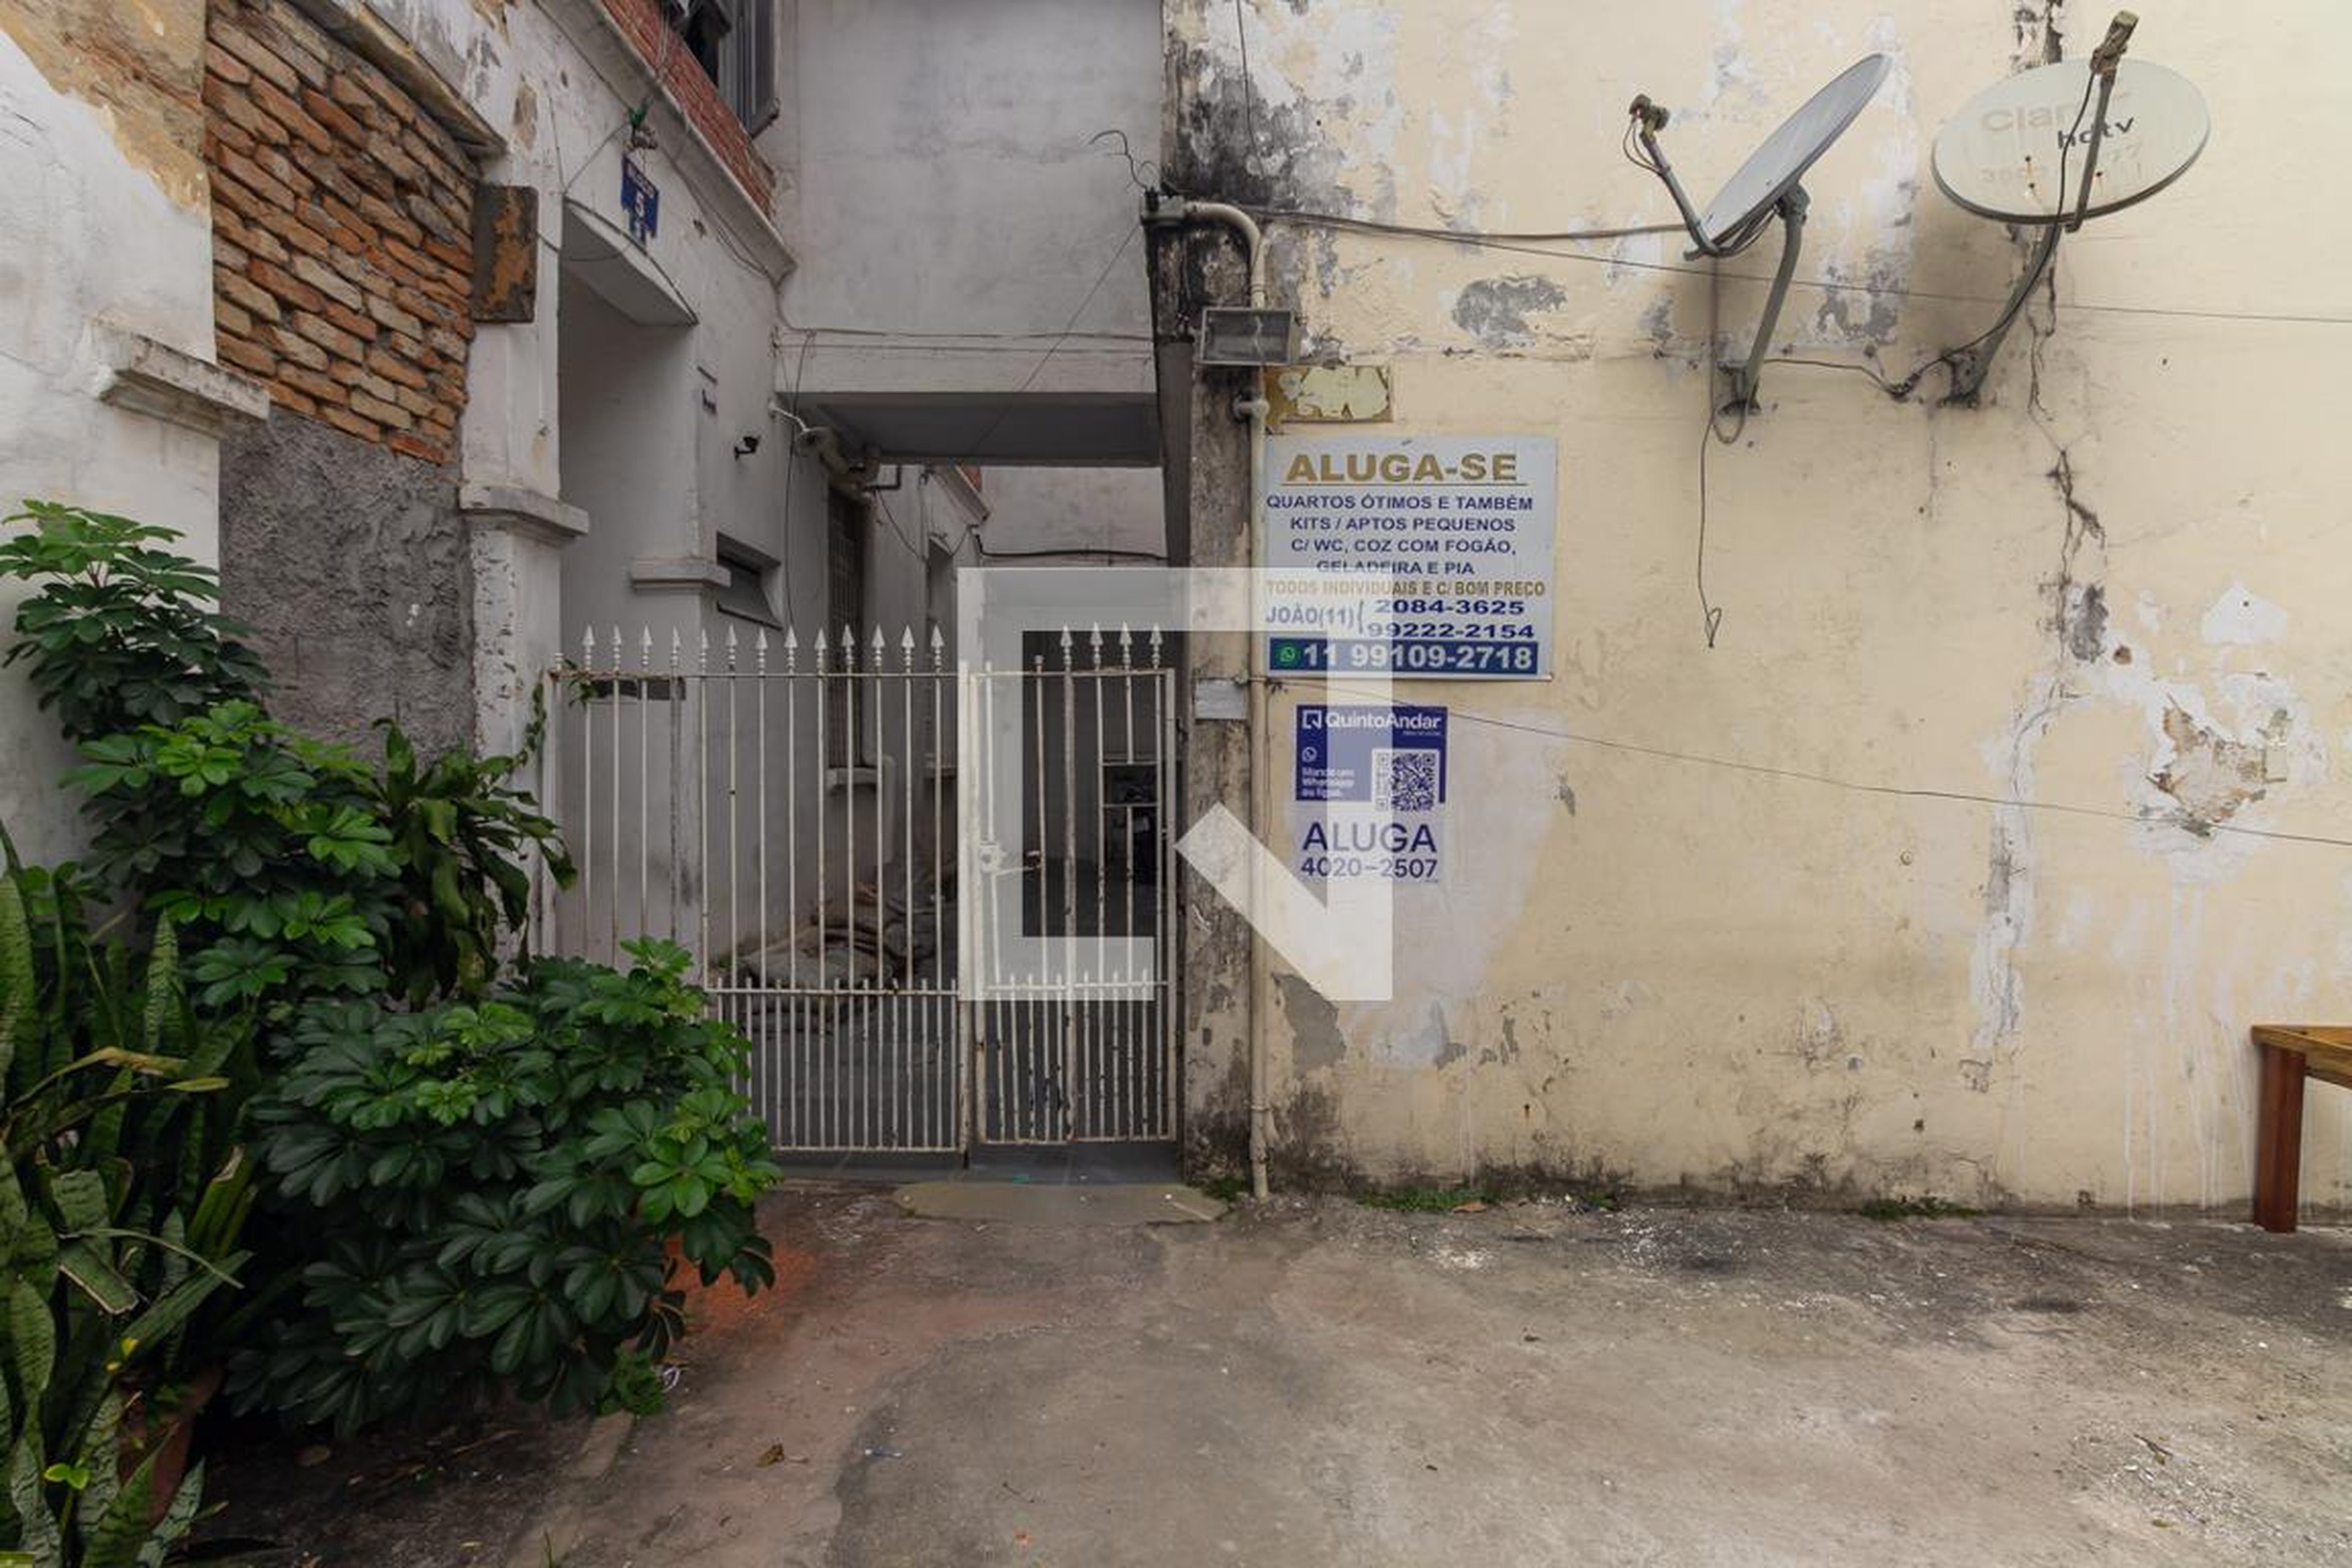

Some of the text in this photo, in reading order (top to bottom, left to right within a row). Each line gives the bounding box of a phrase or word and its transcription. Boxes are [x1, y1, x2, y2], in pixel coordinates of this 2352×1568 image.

[1287, 454, 1517, 482] ALUGA-SE
[1266, 492, 1533, 510] QUARTOS ÓTIMOS E TAMBÉM
[1291, 517, 1331, 530] KITS
[1346, 518, 1407, 531] APTOS
[1412, 518, 1516, 532] PEQUENOS
[1291, 538, 1309, 551] C/
[1314, 539, 1349, 554] WC,
[1354, 540, 1392, 552] COZ
[1397, 540, 1439, 552] COM
[1317, 560, 1476, 575] GELADEIRA E PIA
[1322, 581, 1417, 595] INDIVIDUAIS
[1422, 581, 1431, 595] E
[1455, 581, 1490, 595] BOM
[1374, 598, 1525, 615] 2084-3625
[1368, 621, 1535, 639] 99222-2154
[1305, 644, 1533, 669] 11 99109-2718
[1326, 711, 1442, 729] QuintoAndar
[1302, 821, 1438, 853] ALUGA
[1301, 857, 1438, 878] 4020-2507
